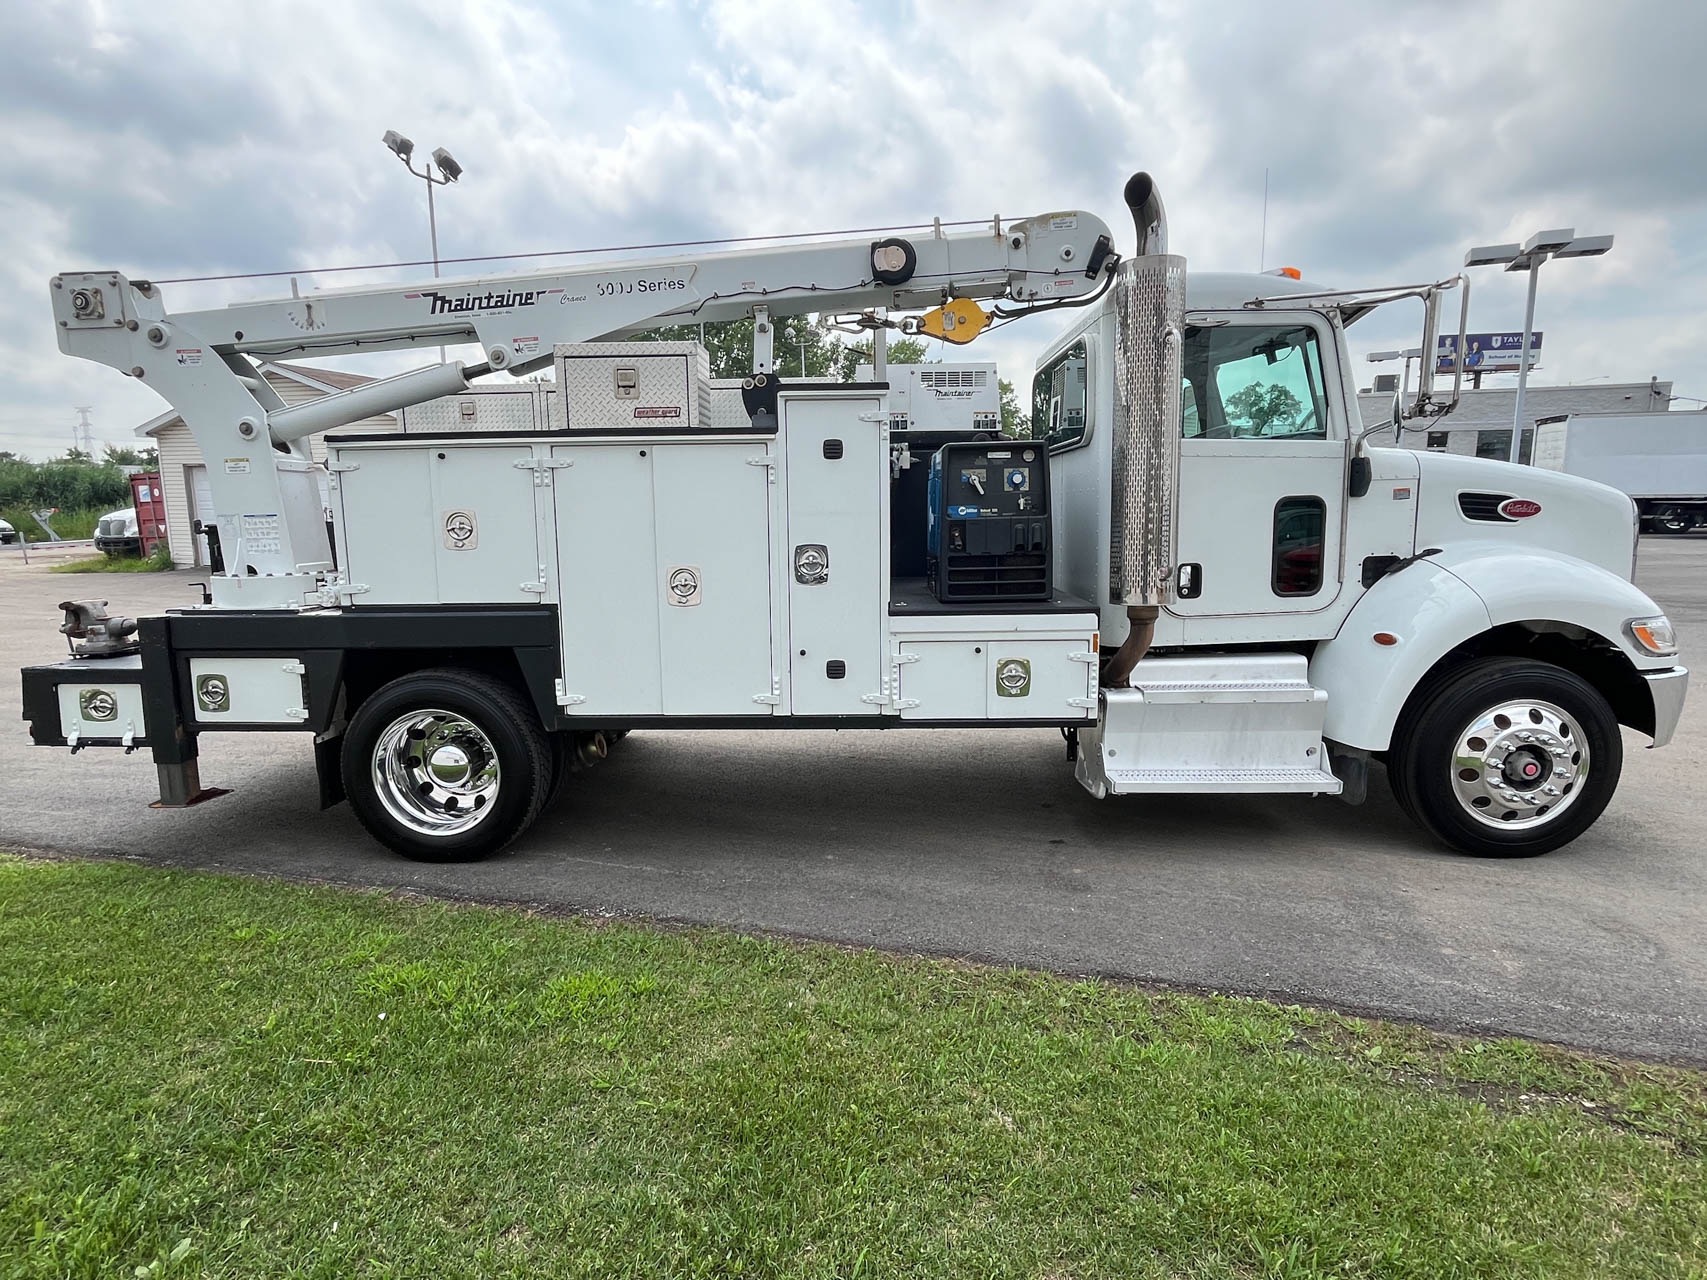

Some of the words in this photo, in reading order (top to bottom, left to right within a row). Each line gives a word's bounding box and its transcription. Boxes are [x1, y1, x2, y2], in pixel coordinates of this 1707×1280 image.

[637, 277, 686, 293] Series
[420, 288, 548, 315] Maintainer
[560, 294, 587, 305] Cranes
[1503, 335, 1536, 343] TAYLR
[933, 388, 976, 397] Maintainer
